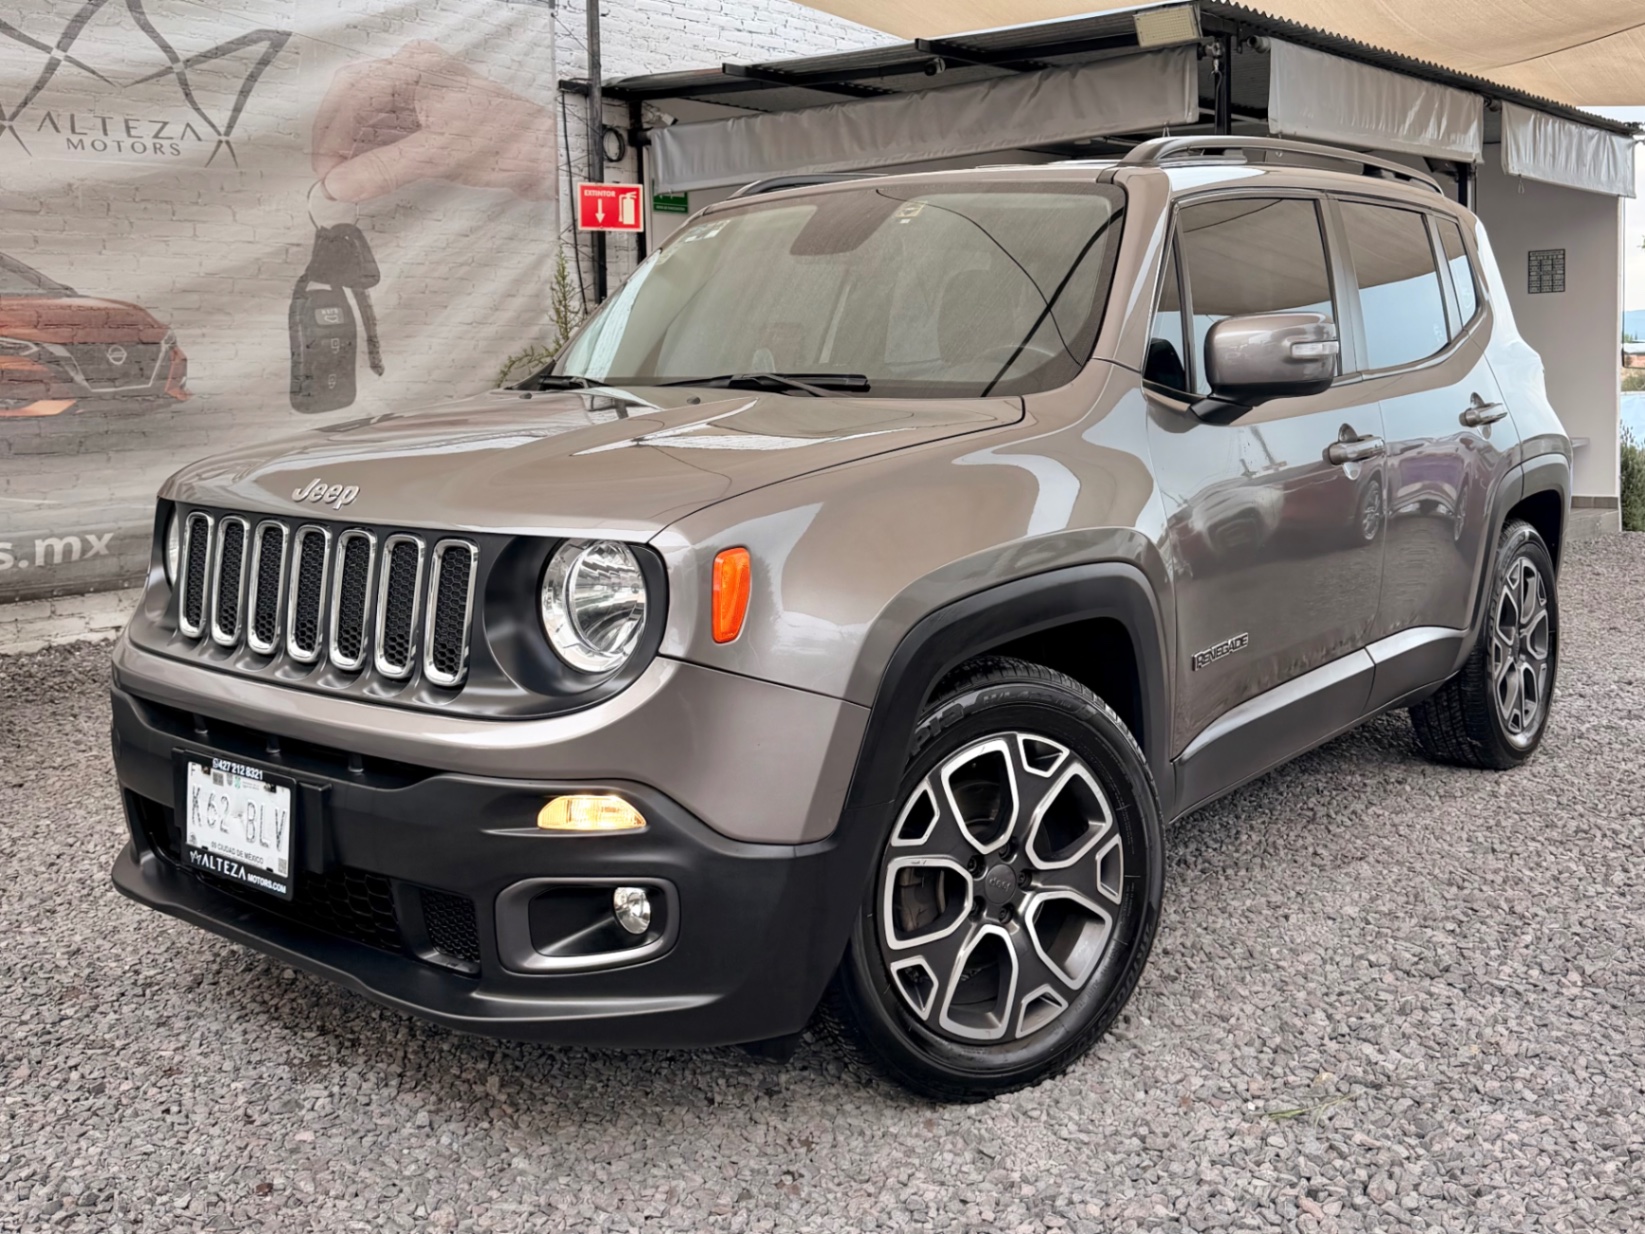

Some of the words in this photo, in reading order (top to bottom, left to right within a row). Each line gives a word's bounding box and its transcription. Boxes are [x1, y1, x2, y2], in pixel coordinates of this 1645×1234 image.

[37, 111, 202, 142] ALTEZA
[66, 137, 181, 157] MOTORS
[584, 189, 616, 197] EXTINTOR
[291, 478, 359, 510] Jeep
[1192, 632, 1249, 671] RENEGADE
[231, 762, 245, 775] 212
[202, 853, 247, 880] ALTEZA
